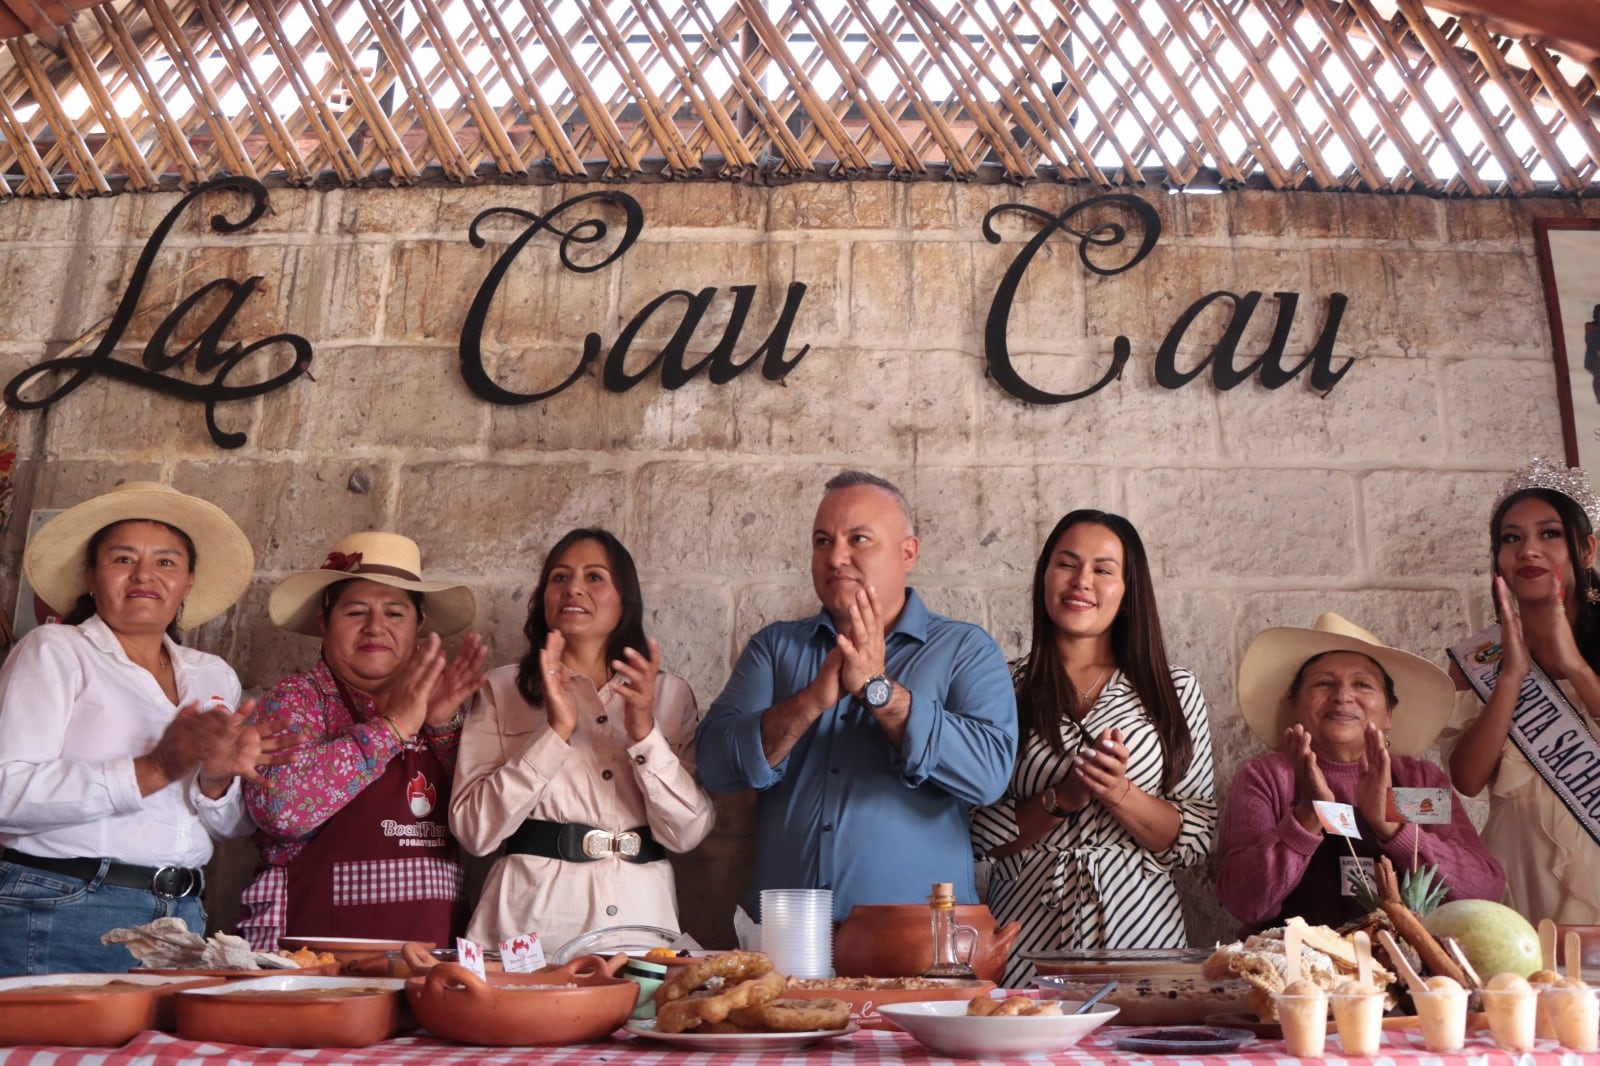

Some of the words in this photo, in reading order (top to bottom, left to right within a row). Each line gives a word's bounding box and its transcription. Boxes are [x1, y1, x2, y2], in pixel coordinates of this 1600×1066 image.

[3, 176, 311, 448] La
[459, 190, 809, 405] Cau
[984, 194, 1354, 404] Cau
